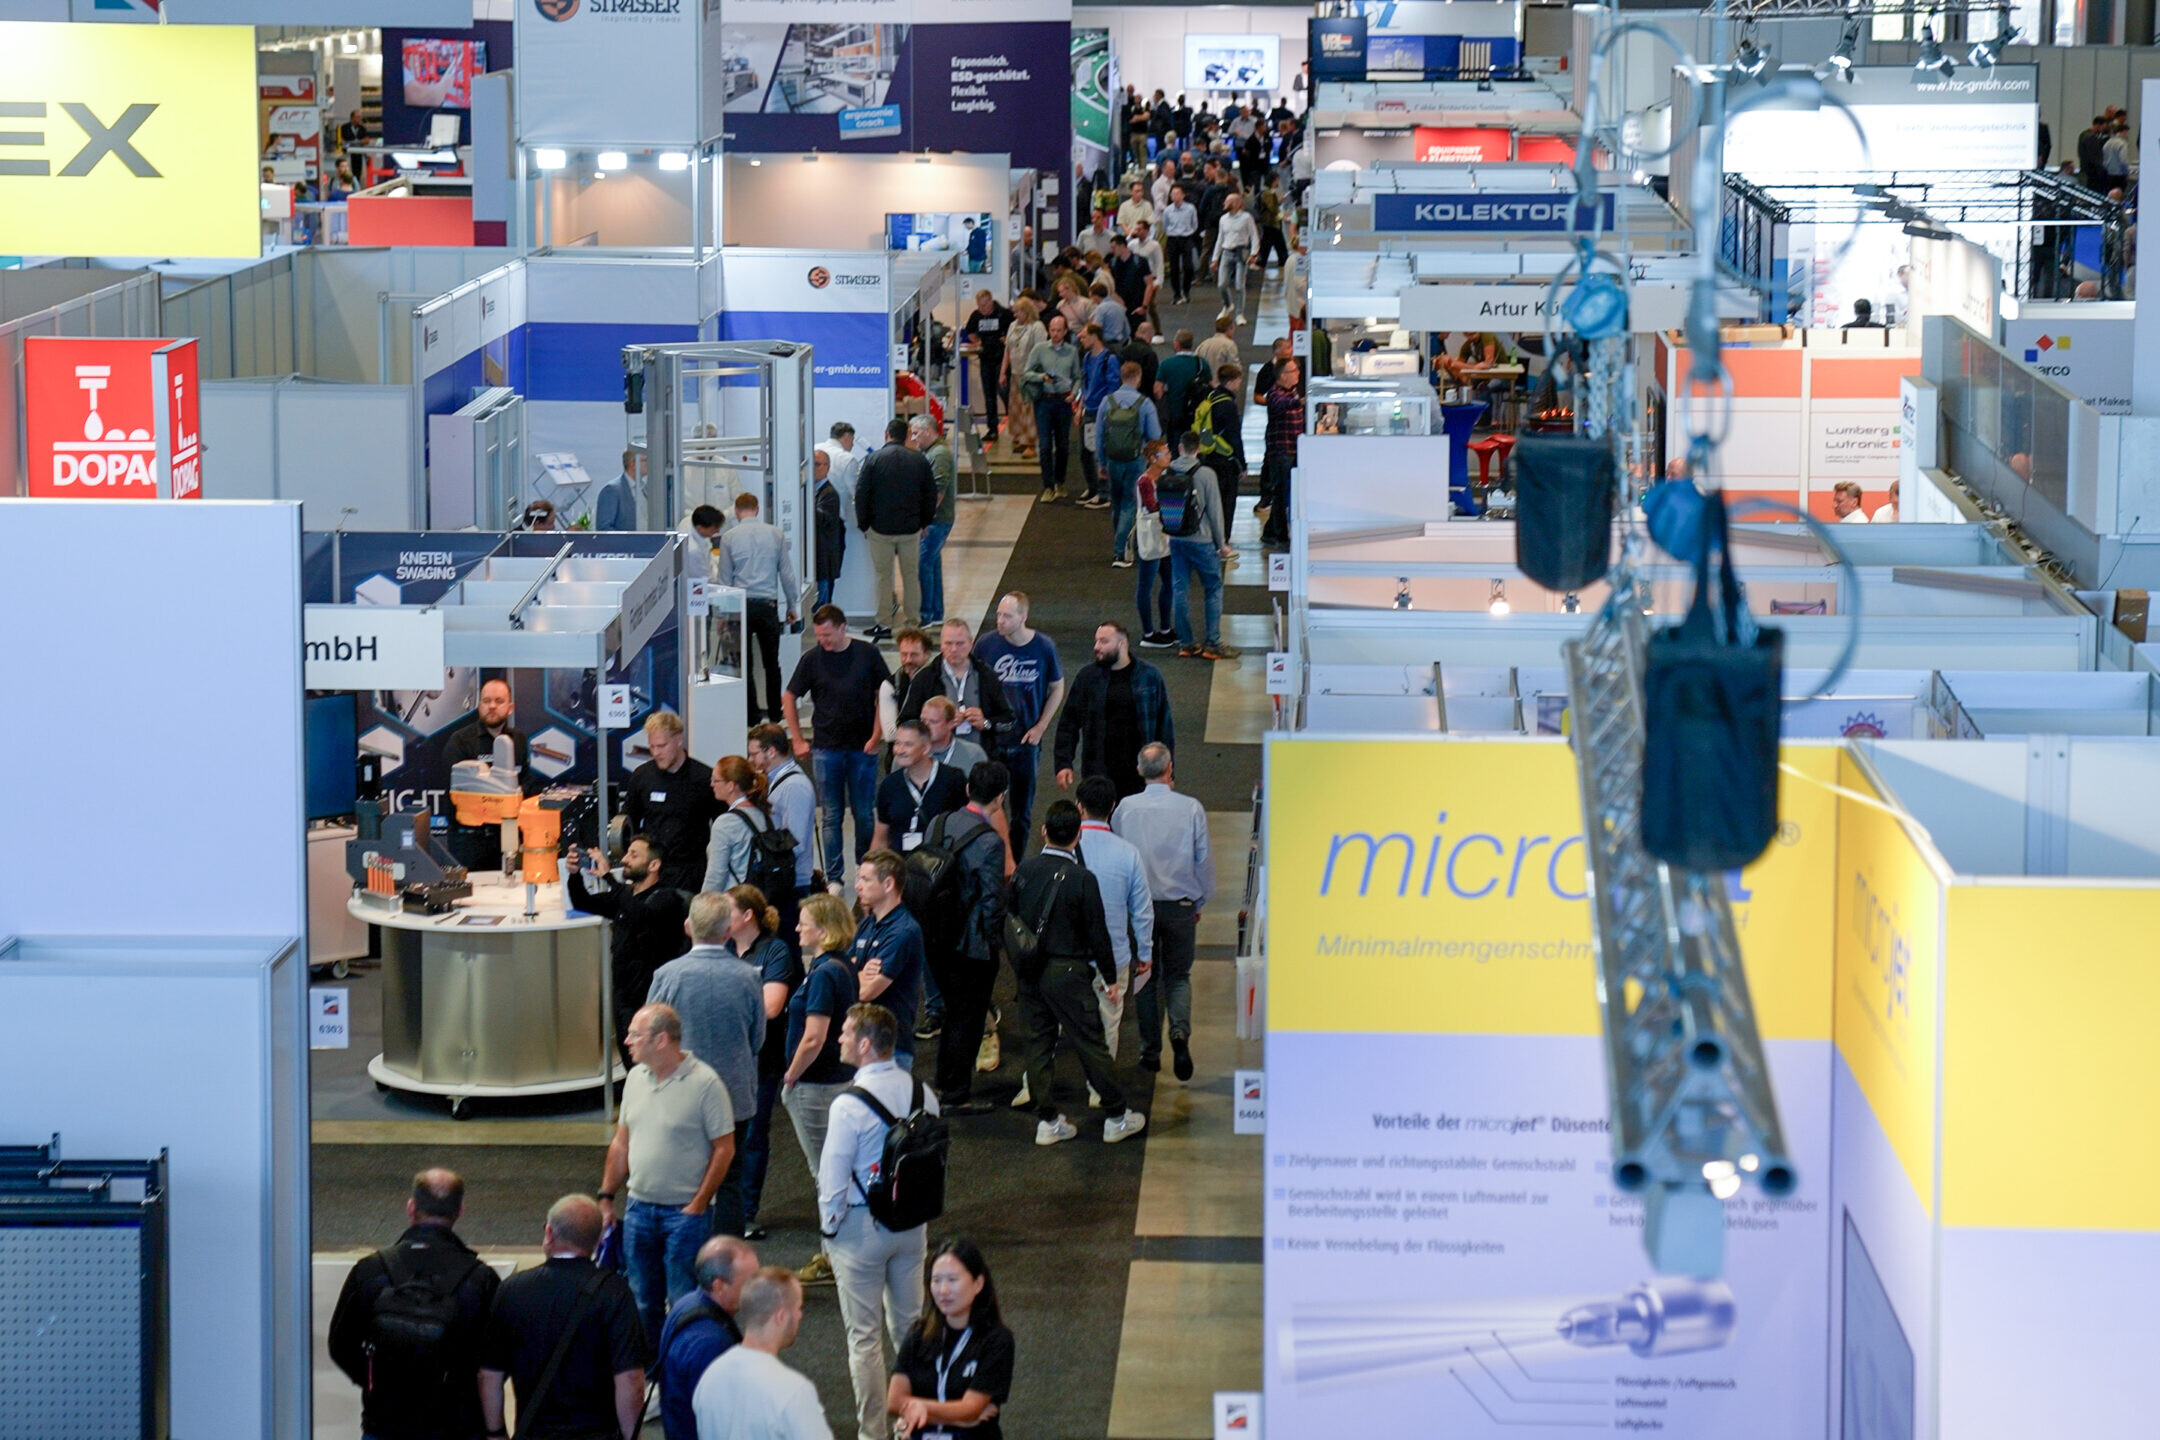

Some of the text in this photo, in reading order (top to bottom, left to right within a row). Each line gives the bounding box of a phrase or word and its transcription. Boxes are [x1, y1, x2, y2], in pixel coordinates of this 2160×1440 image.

[951, 54, 1009, 69] Ergonomisch.
[951, 69, 1031, 84] ESD-geschützt.
[951, 84, 988, 97] Flexibel.
[1917, 79, 2030, 94] www.hz-gmbh.com
[1415, 203, 1570, 221] KOLEKTOR
[1480, 301, 1560, 316] Artur Kü
[813, 364, 881, 376] er-gmbh.com
[2034, 365, 2070, 376] arco
[1825, 425, 1889, 436] Lumberg
[1825, 440, 1889, 449] Lutronic
[53, 454, 157, 486] DOPA
[399, 552, 453, 565] KNETEN
[396, 566, 456, 580] SWAGING
[304, 635, 377, 661] mbH
[1316, 934, 1594, 963] Minimalmengenschm
[1372, 1114, 1430, 1130] Vorteile
[1437, 1114, 1461, 1130] der
[1551, 1117, 1612, 1133] Düsente
[1288, 1154, 1359, 1171] Zielgenauer
[1363, 1155, 1385, 1168] und
[1493, 1157, 1576, 1172] Gemischstrahl
[1288, 1187, 1372, 1202] Gemischstrahl
[1376, 1189, 1402, 1202] wird
[1406, 1190, 1417, 1202] in
[1422, 1190, 1459, 1203] einem
[1288, 1205, 1449, 1222] Bearbeitungsstelle geleitet
[1287, 1237, 1320, 1251] Keine
[1404, 1239, 1424, 1252] der
